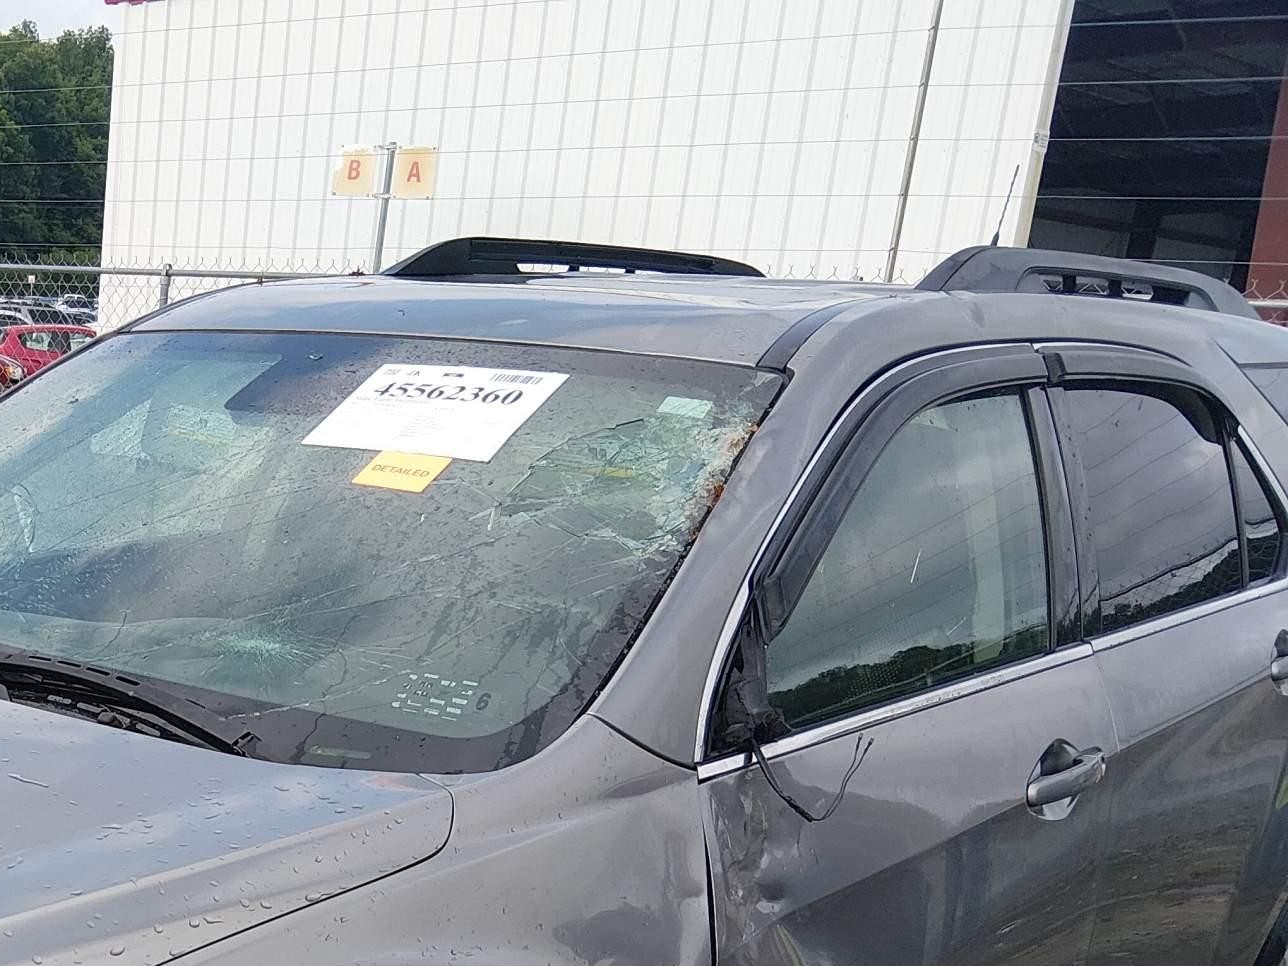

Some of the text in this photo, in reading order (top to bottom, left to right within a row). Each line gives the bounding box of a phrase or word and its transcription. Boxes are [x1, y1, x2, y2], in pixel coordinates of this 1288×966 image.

[347, 159, 361, 181] B
[406, 161, 421, 183] A
[373, 381, 524, 406] 45562360
[371, 464, 430, 477] DETAILED
